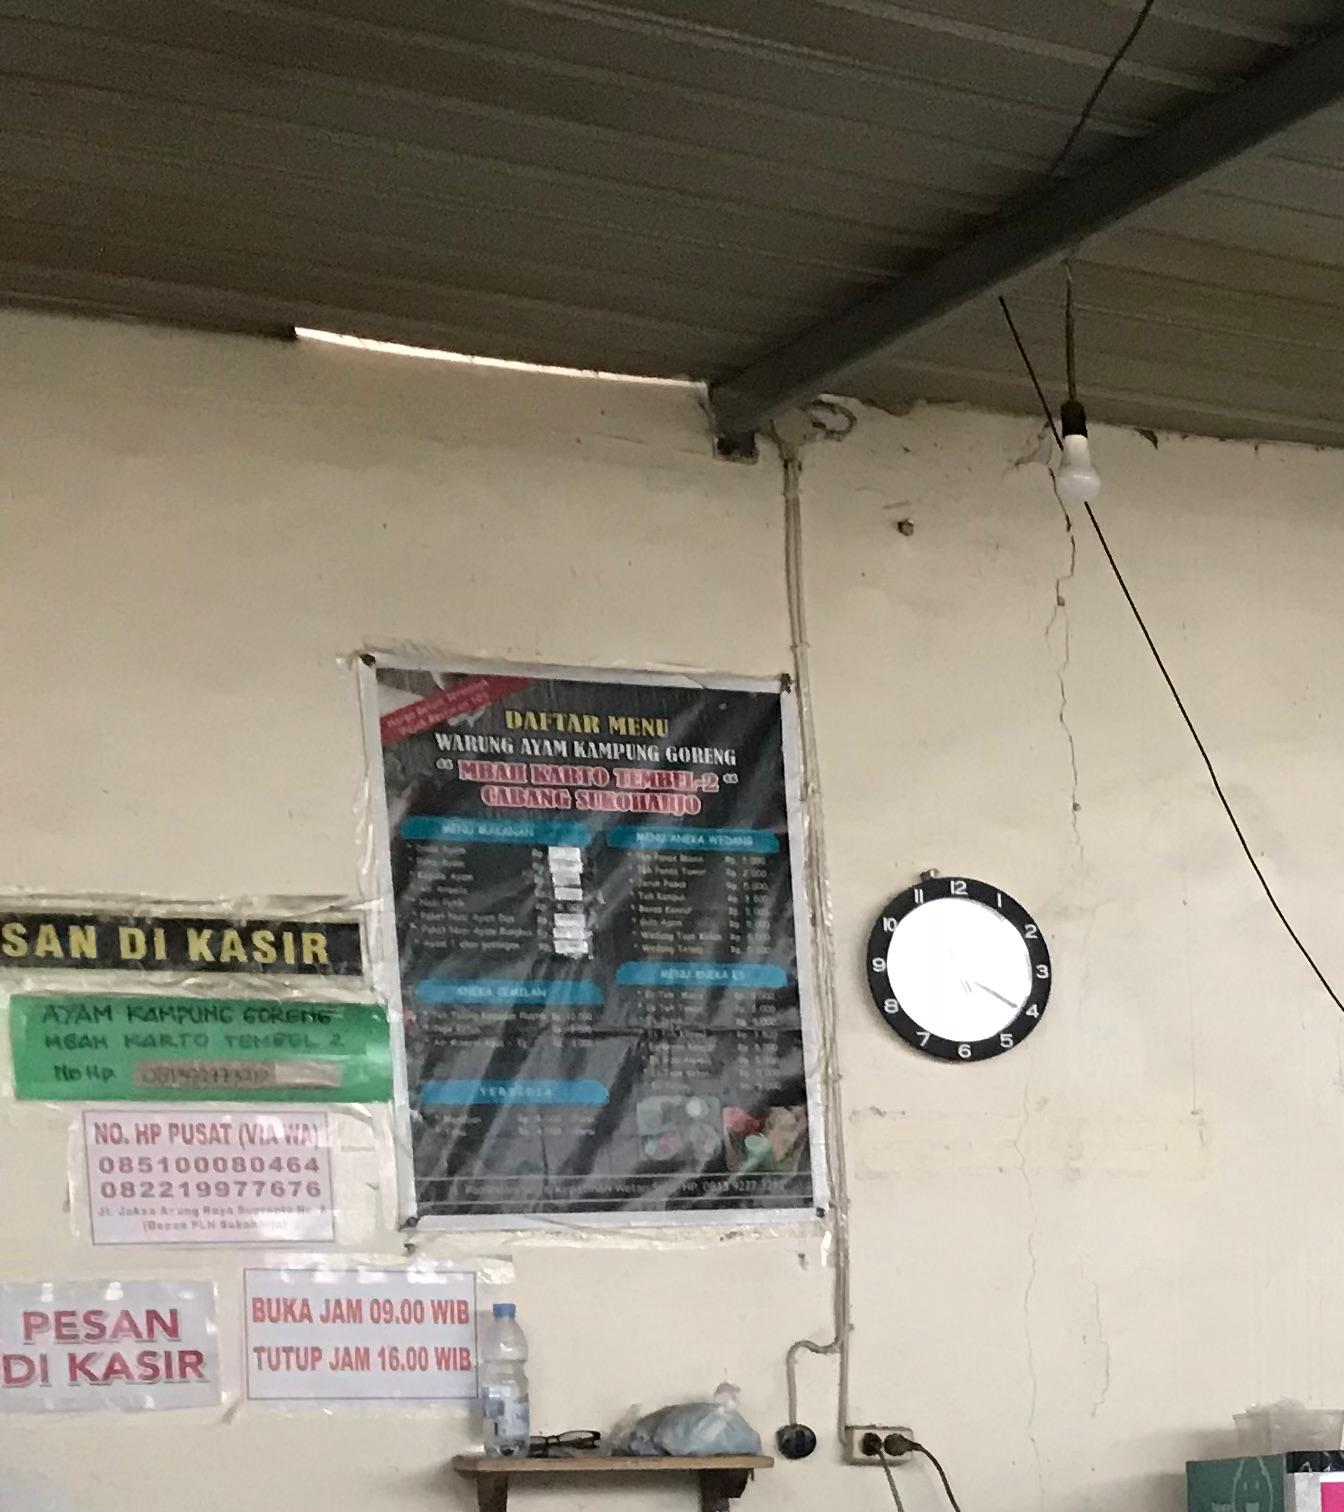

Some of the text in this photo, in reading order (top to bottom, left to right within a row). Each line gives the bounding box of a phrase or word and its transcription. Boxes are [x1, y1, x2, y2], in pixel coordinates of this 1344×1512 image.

[505, 710, 669, 737] DAFTAR MENU
[434, 732, 737, 766] WARUNG AYAM KAMPUNG GORENG
[457, 759, 528, 782] MBAH
[530, 763, 610, 787] KARTO
[480, 784, 702, 815] CABANG SUKOHARJO
[914, 889, 924, 904] 11
[950, 881, 967, 895] 12
[883, 918, 897, 932] 10
[1025, 924, 1037, 939] 2
[118, 928, 166, 961] DI
[187, 928, 329, 965] KASIR
[872, 957, 886, 972] 9
[1036, 965, 1049, 979] 3
[42, 1005, 333, 1025] AYAM KAMPUNG GORENG
[884, 999, 898, 1014] 8
[1026, 1004, 1039, 1018] 4
[124, 1034, 210, 1049] KARTO
[916, 1031, 930, 1047] 7
[1000, 1034, 1014, 1048] 5
[958, 1044, 972, 1058] 6
[94, 1122, 131, 1145] NO.
[135, 1124, 162, 1145] HP
[168, 1123, 232, 1145] PUSAT
[99, 1156, 320, 1174] 085100080464
[101, 1180, 322, 1199] 082219977676
[252, 1297, 470, 1326] BUKA JAM 09.00 WIB
[22, 1309, 180, 1342] PESAN
[253, 1345, 472, 1372] TUTUP JAM 16.00 WIB
[1, 1350, 207, 1387] DI KASIR
